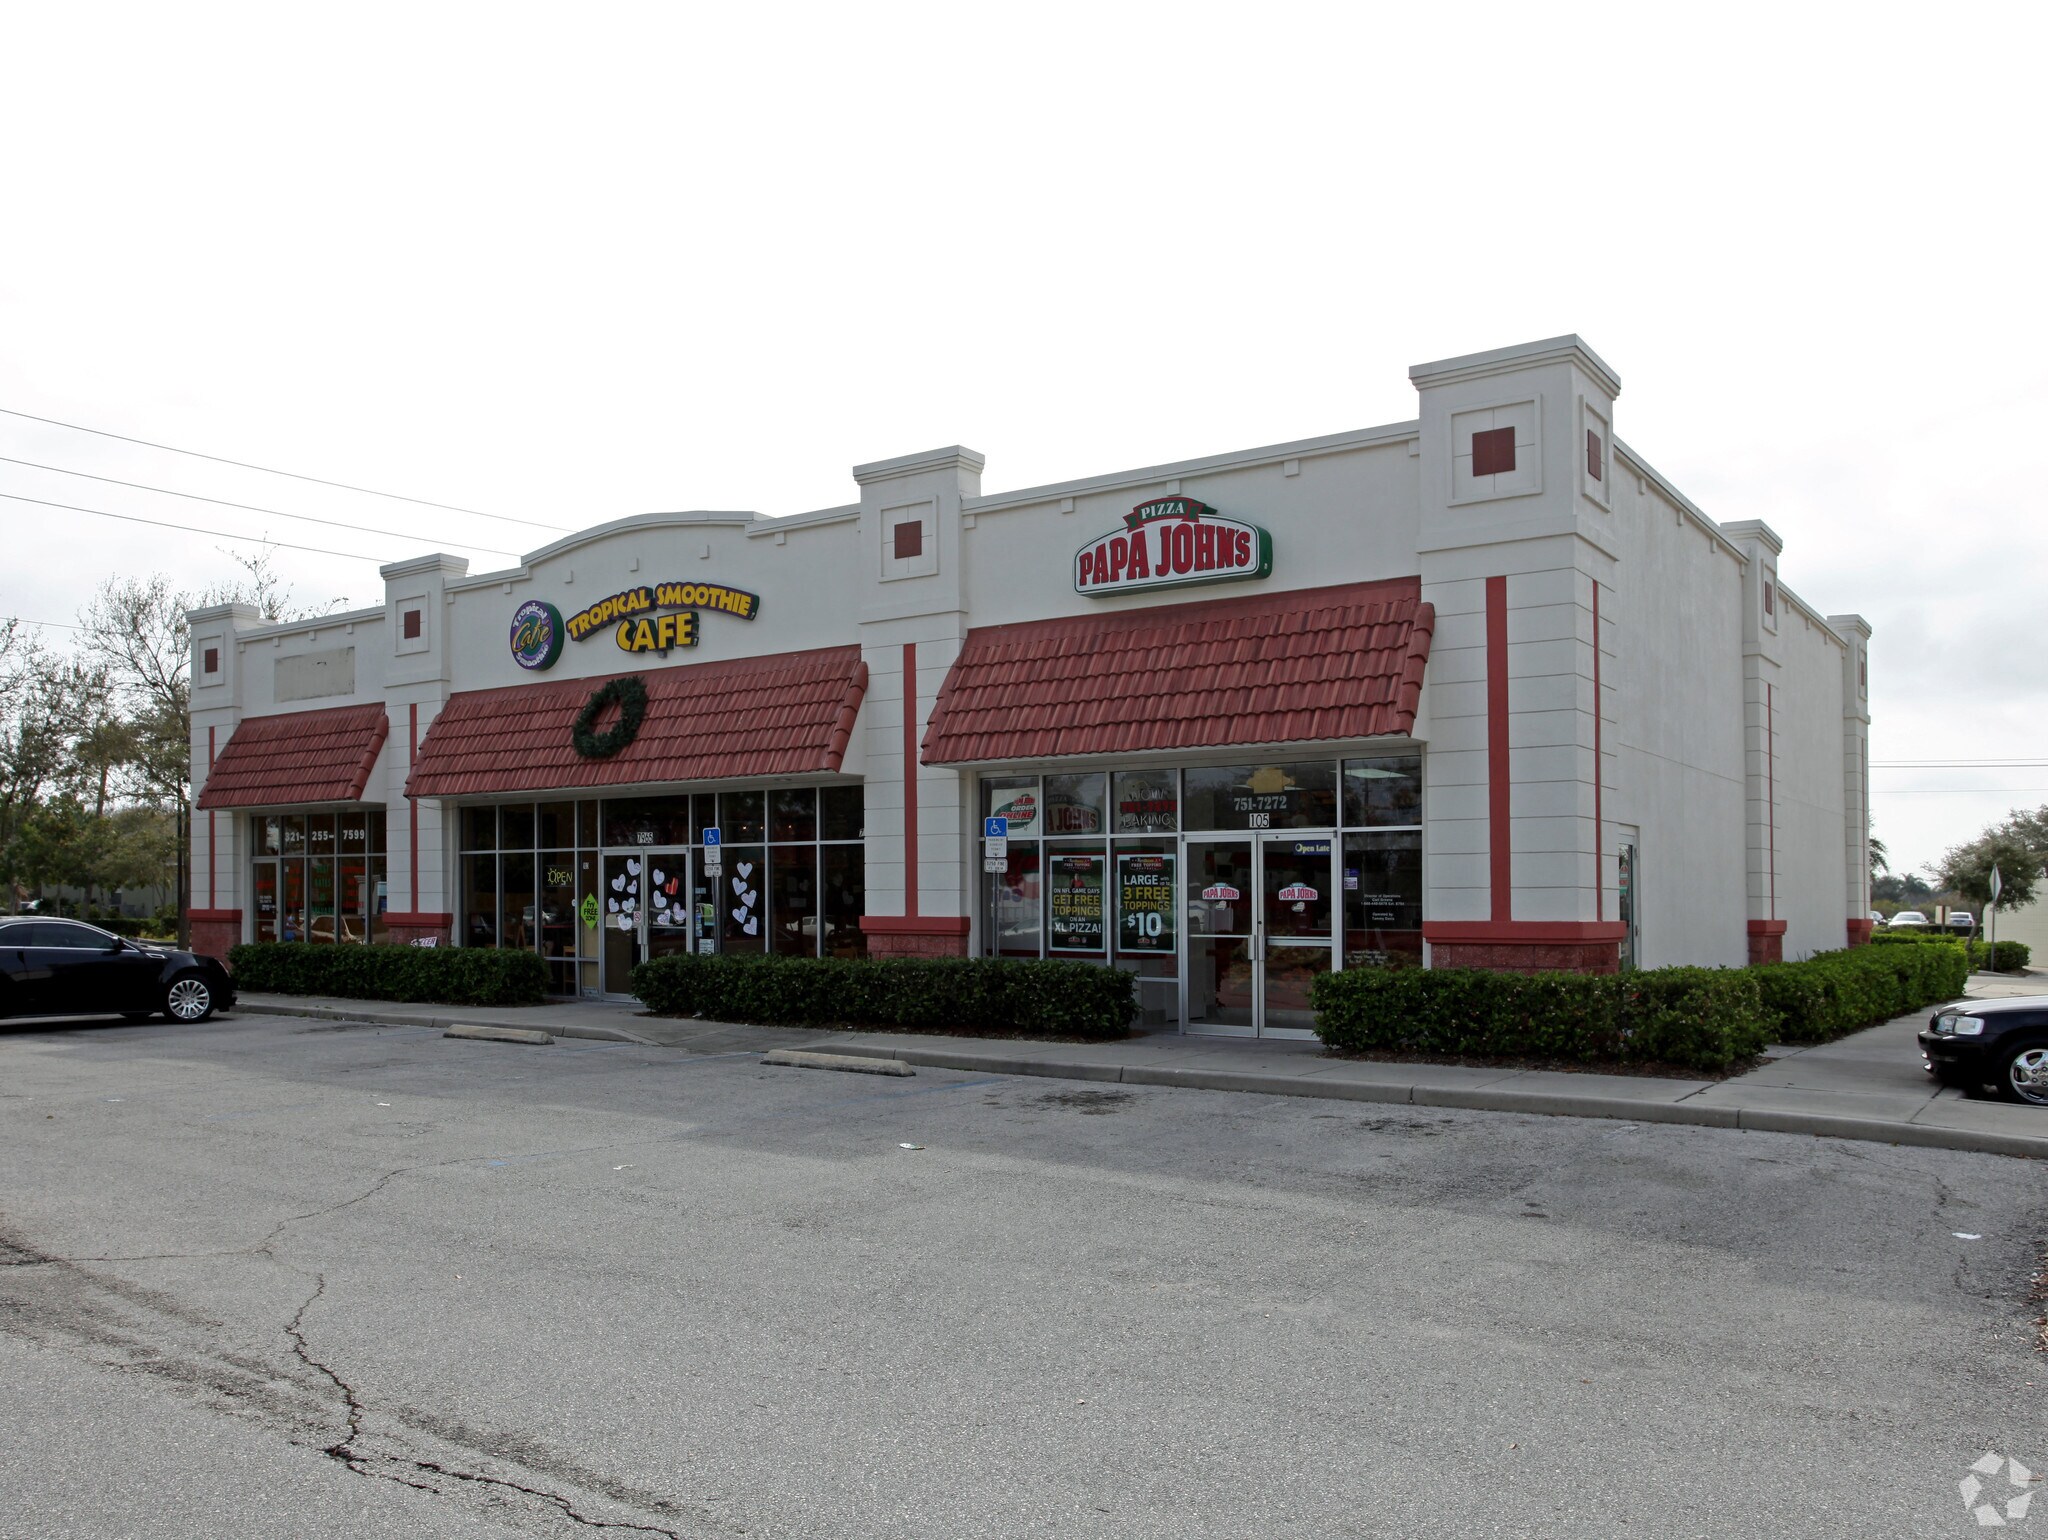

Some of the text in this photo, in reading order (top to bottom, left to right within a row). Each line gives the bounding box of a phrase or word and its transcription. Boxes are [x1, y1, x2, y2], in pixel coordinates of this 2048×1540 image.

[1140, 501, 1185, 520] PIZZA
[1078, 523, 1251, 586] PAPA JOHN'S
[513, 603, 548, 627] Tropical
[567, 586, 752, 639] TROPICAL SMOOTHIE
[616, 613, 693, 652] CAFE
[515, 644, 549, 667] Smoothie
[1011, 804, 1035, 812] ORDER
[1233, 795, 1288, 811] 751-7272
[1123, 813, 1171, 827] BAKING
[1250, 814, 1269, 827] 105
[311, 830, 334, 841] 255-
[342, 829, 365, 840] 7599
[1294, 843, 1330, 854] Open Late
[547, 869, 573, 884] OPEN
[1124, 874, 1159, 885] LARGE
[1124, 887, 1170, 900] 3 FREE
[1203, 888, 1218, 898] PAPA
[1280, 889, 1295, 899] PAPA
[586, 900, 594, 908] Fry
[1054, 895, 1100, 905] GET FREE
[1124, 901, 1170, 911] TOPPINGS
[1054, 905, 1101, 916] TOPPINGS
[1054, 922, 1101, 934] XL PIZZA!
[1128, 911, 1162, 937] $10
